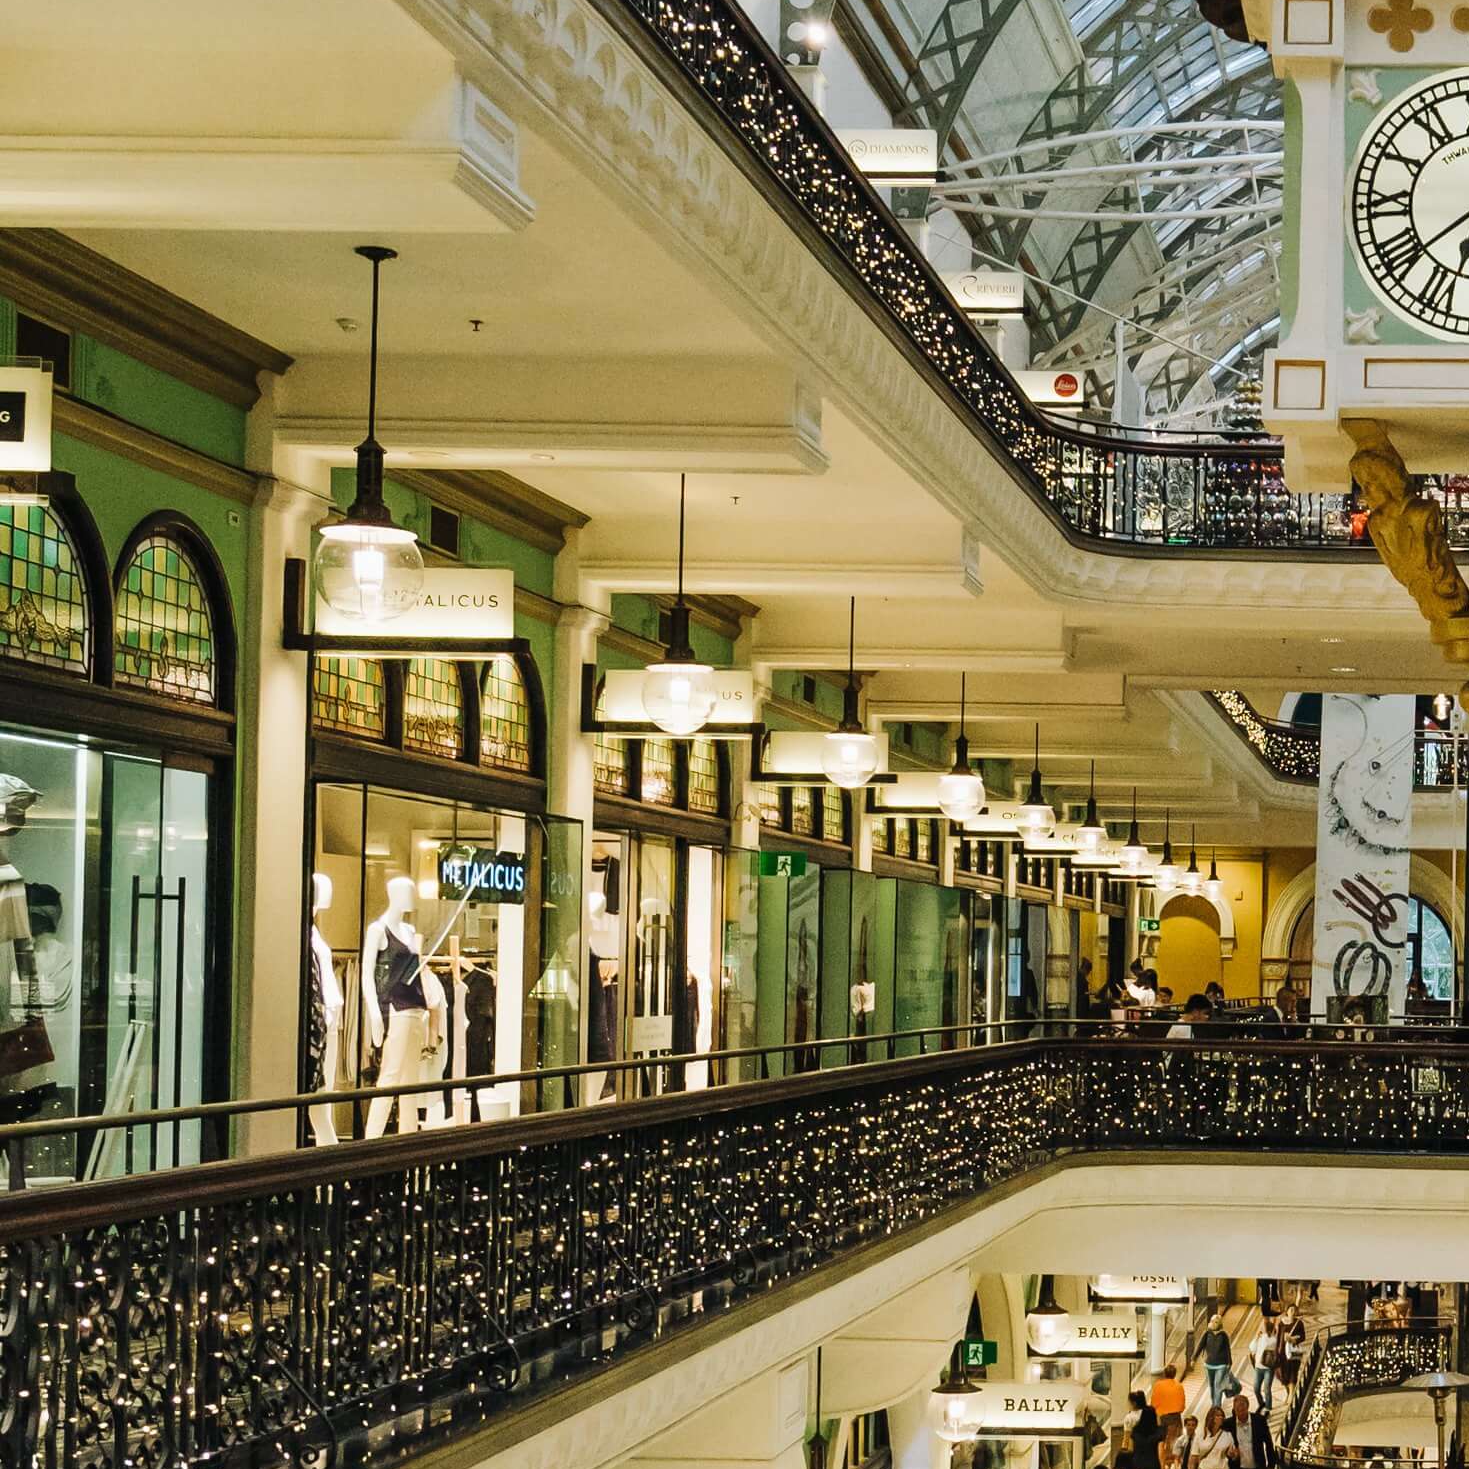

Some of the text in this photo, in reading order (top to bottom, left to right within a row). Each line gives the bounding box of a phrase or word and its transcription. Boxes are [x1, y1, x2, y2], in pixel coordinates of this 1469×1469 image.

[870, 144, 929, 155] DIAMONDS
[442, 860, 524, 892] METALICUS
[1078, 1327, 1132, 1338] BALLY
[1004, 1398, 1068, 1412] BALLY
